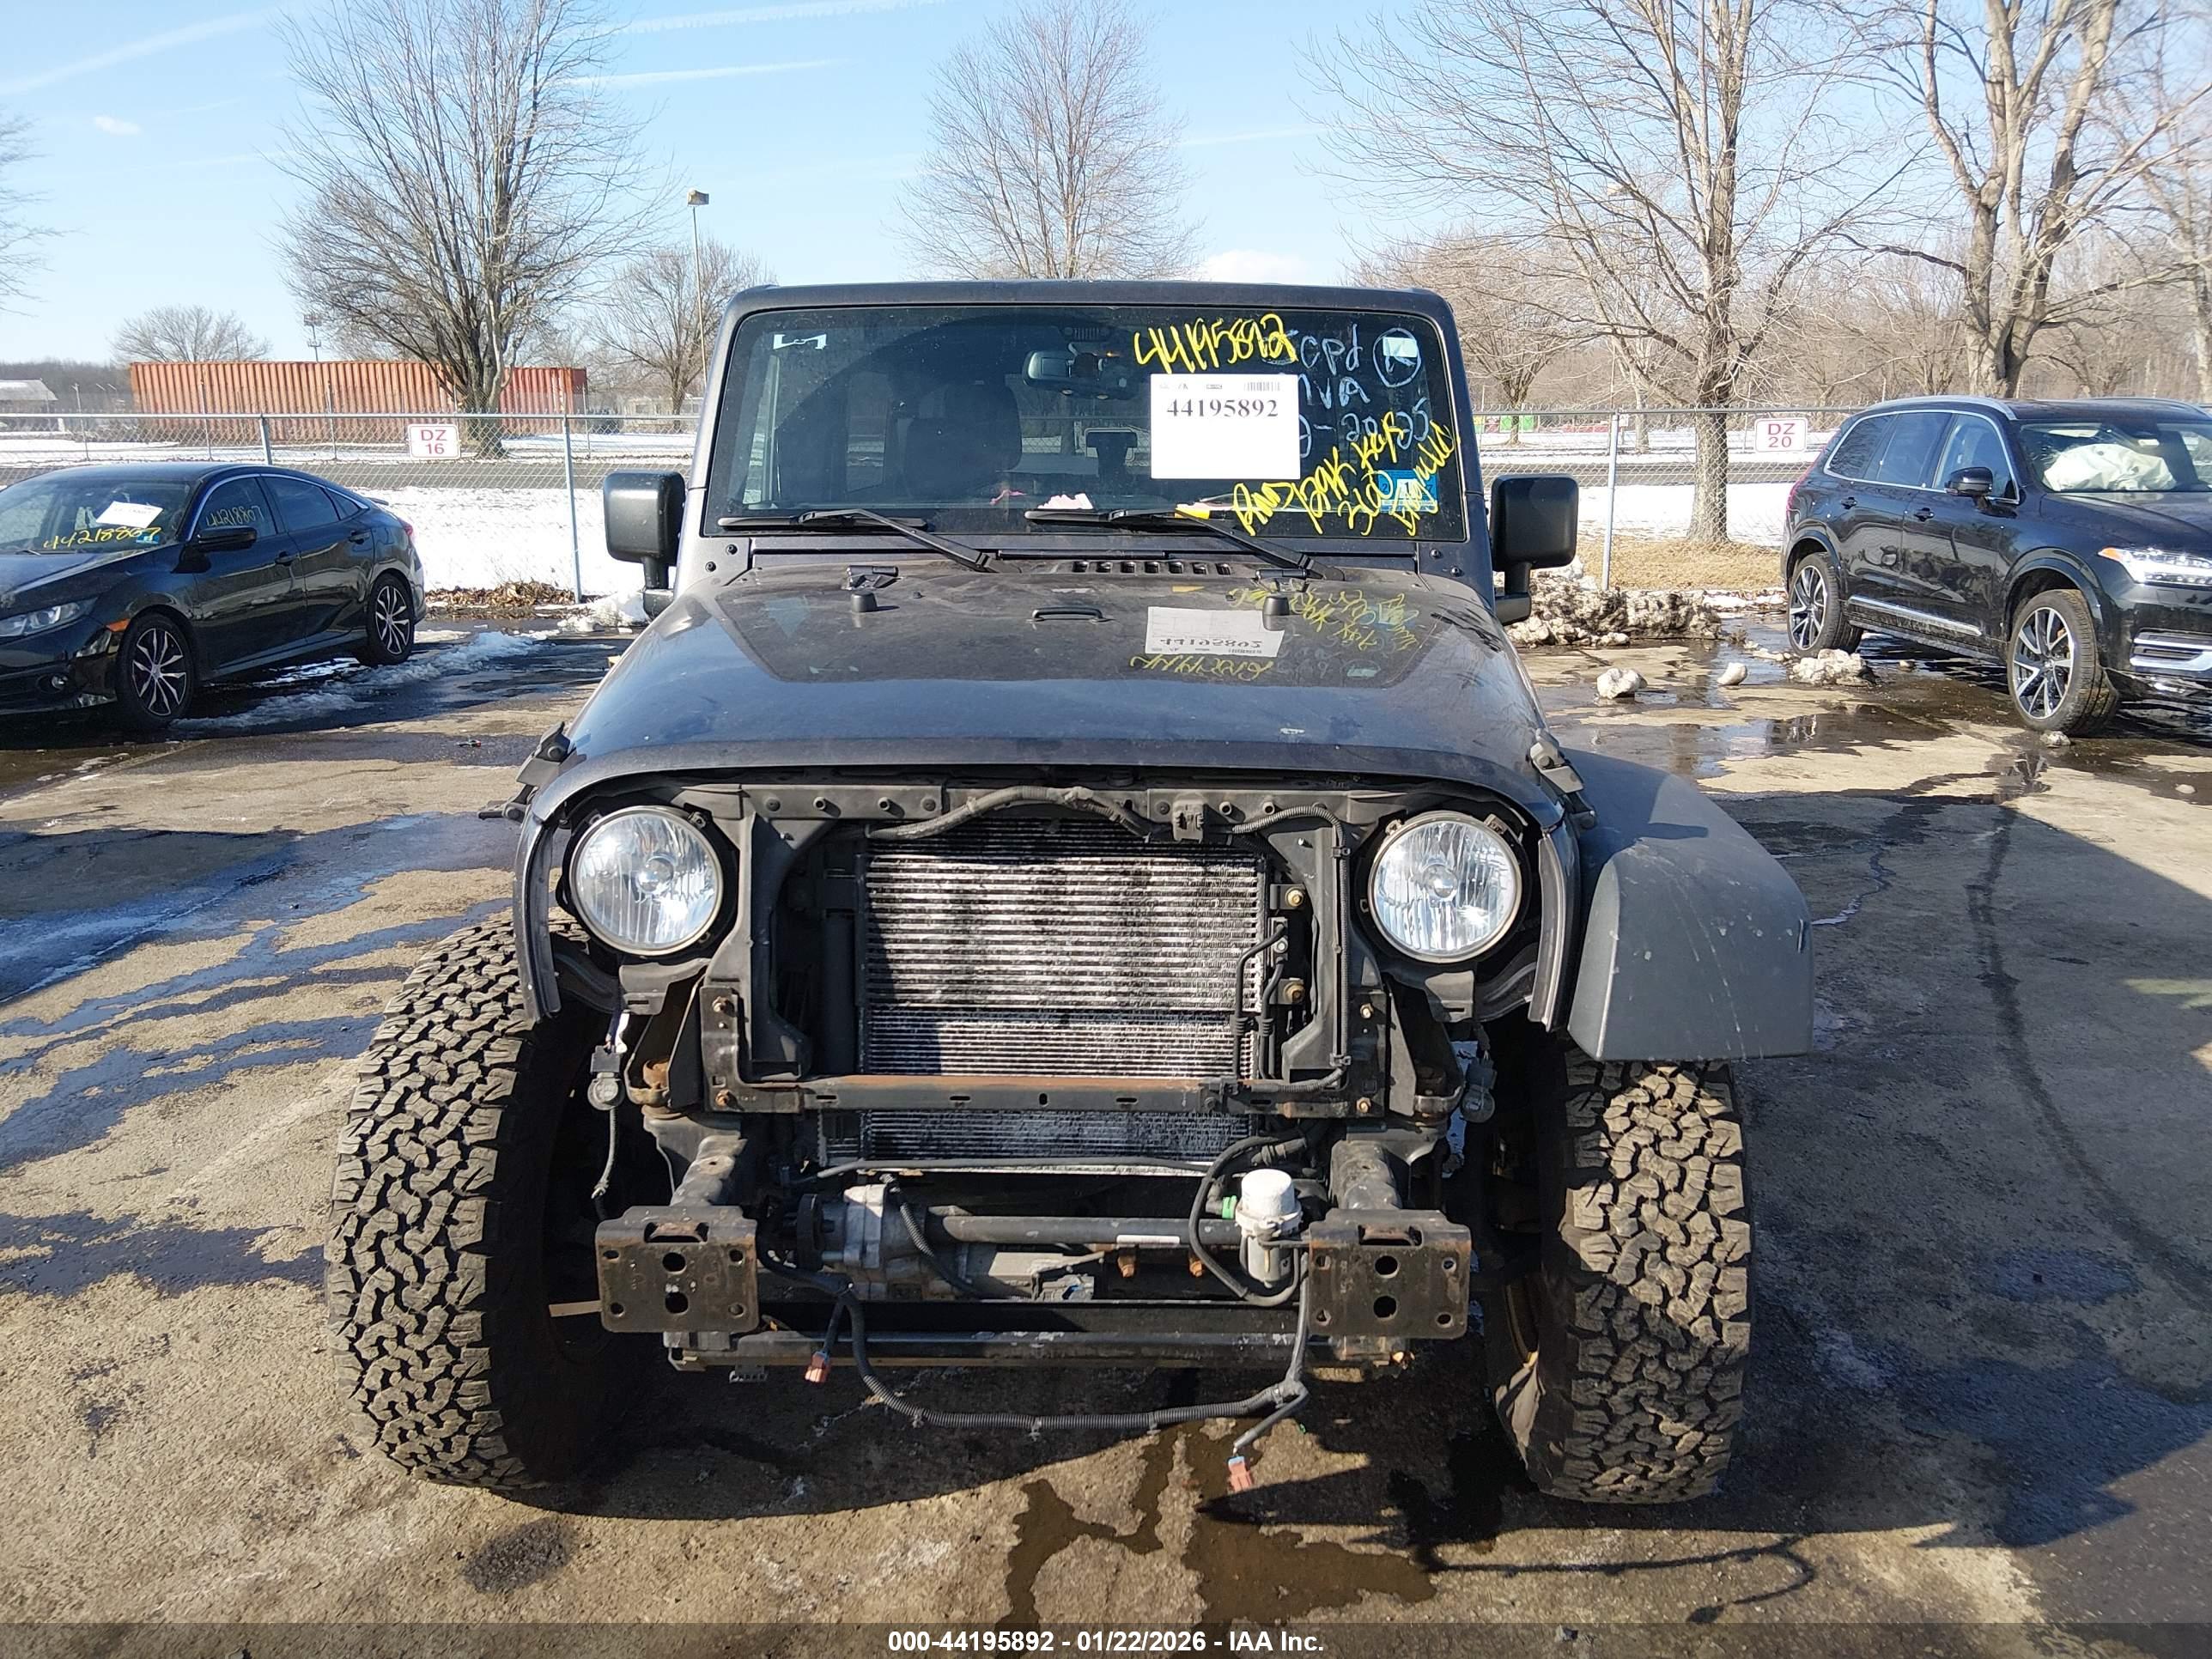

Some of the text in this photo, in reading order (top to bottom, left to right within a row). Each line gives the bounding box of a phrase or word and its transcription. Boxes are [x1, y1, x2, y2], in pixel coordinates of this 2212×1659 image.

[1167, 398, 1279, 417] 44195892
[421, 429, 447, 441] DZ
[1768, 422, 1796, 435] DZ
[425, 443, 445, 454] 16
[1768, 436, 1792, 448] 20
[205, 505, 264, 527] 44218807
[43, 526, 162, 550] 44218807
